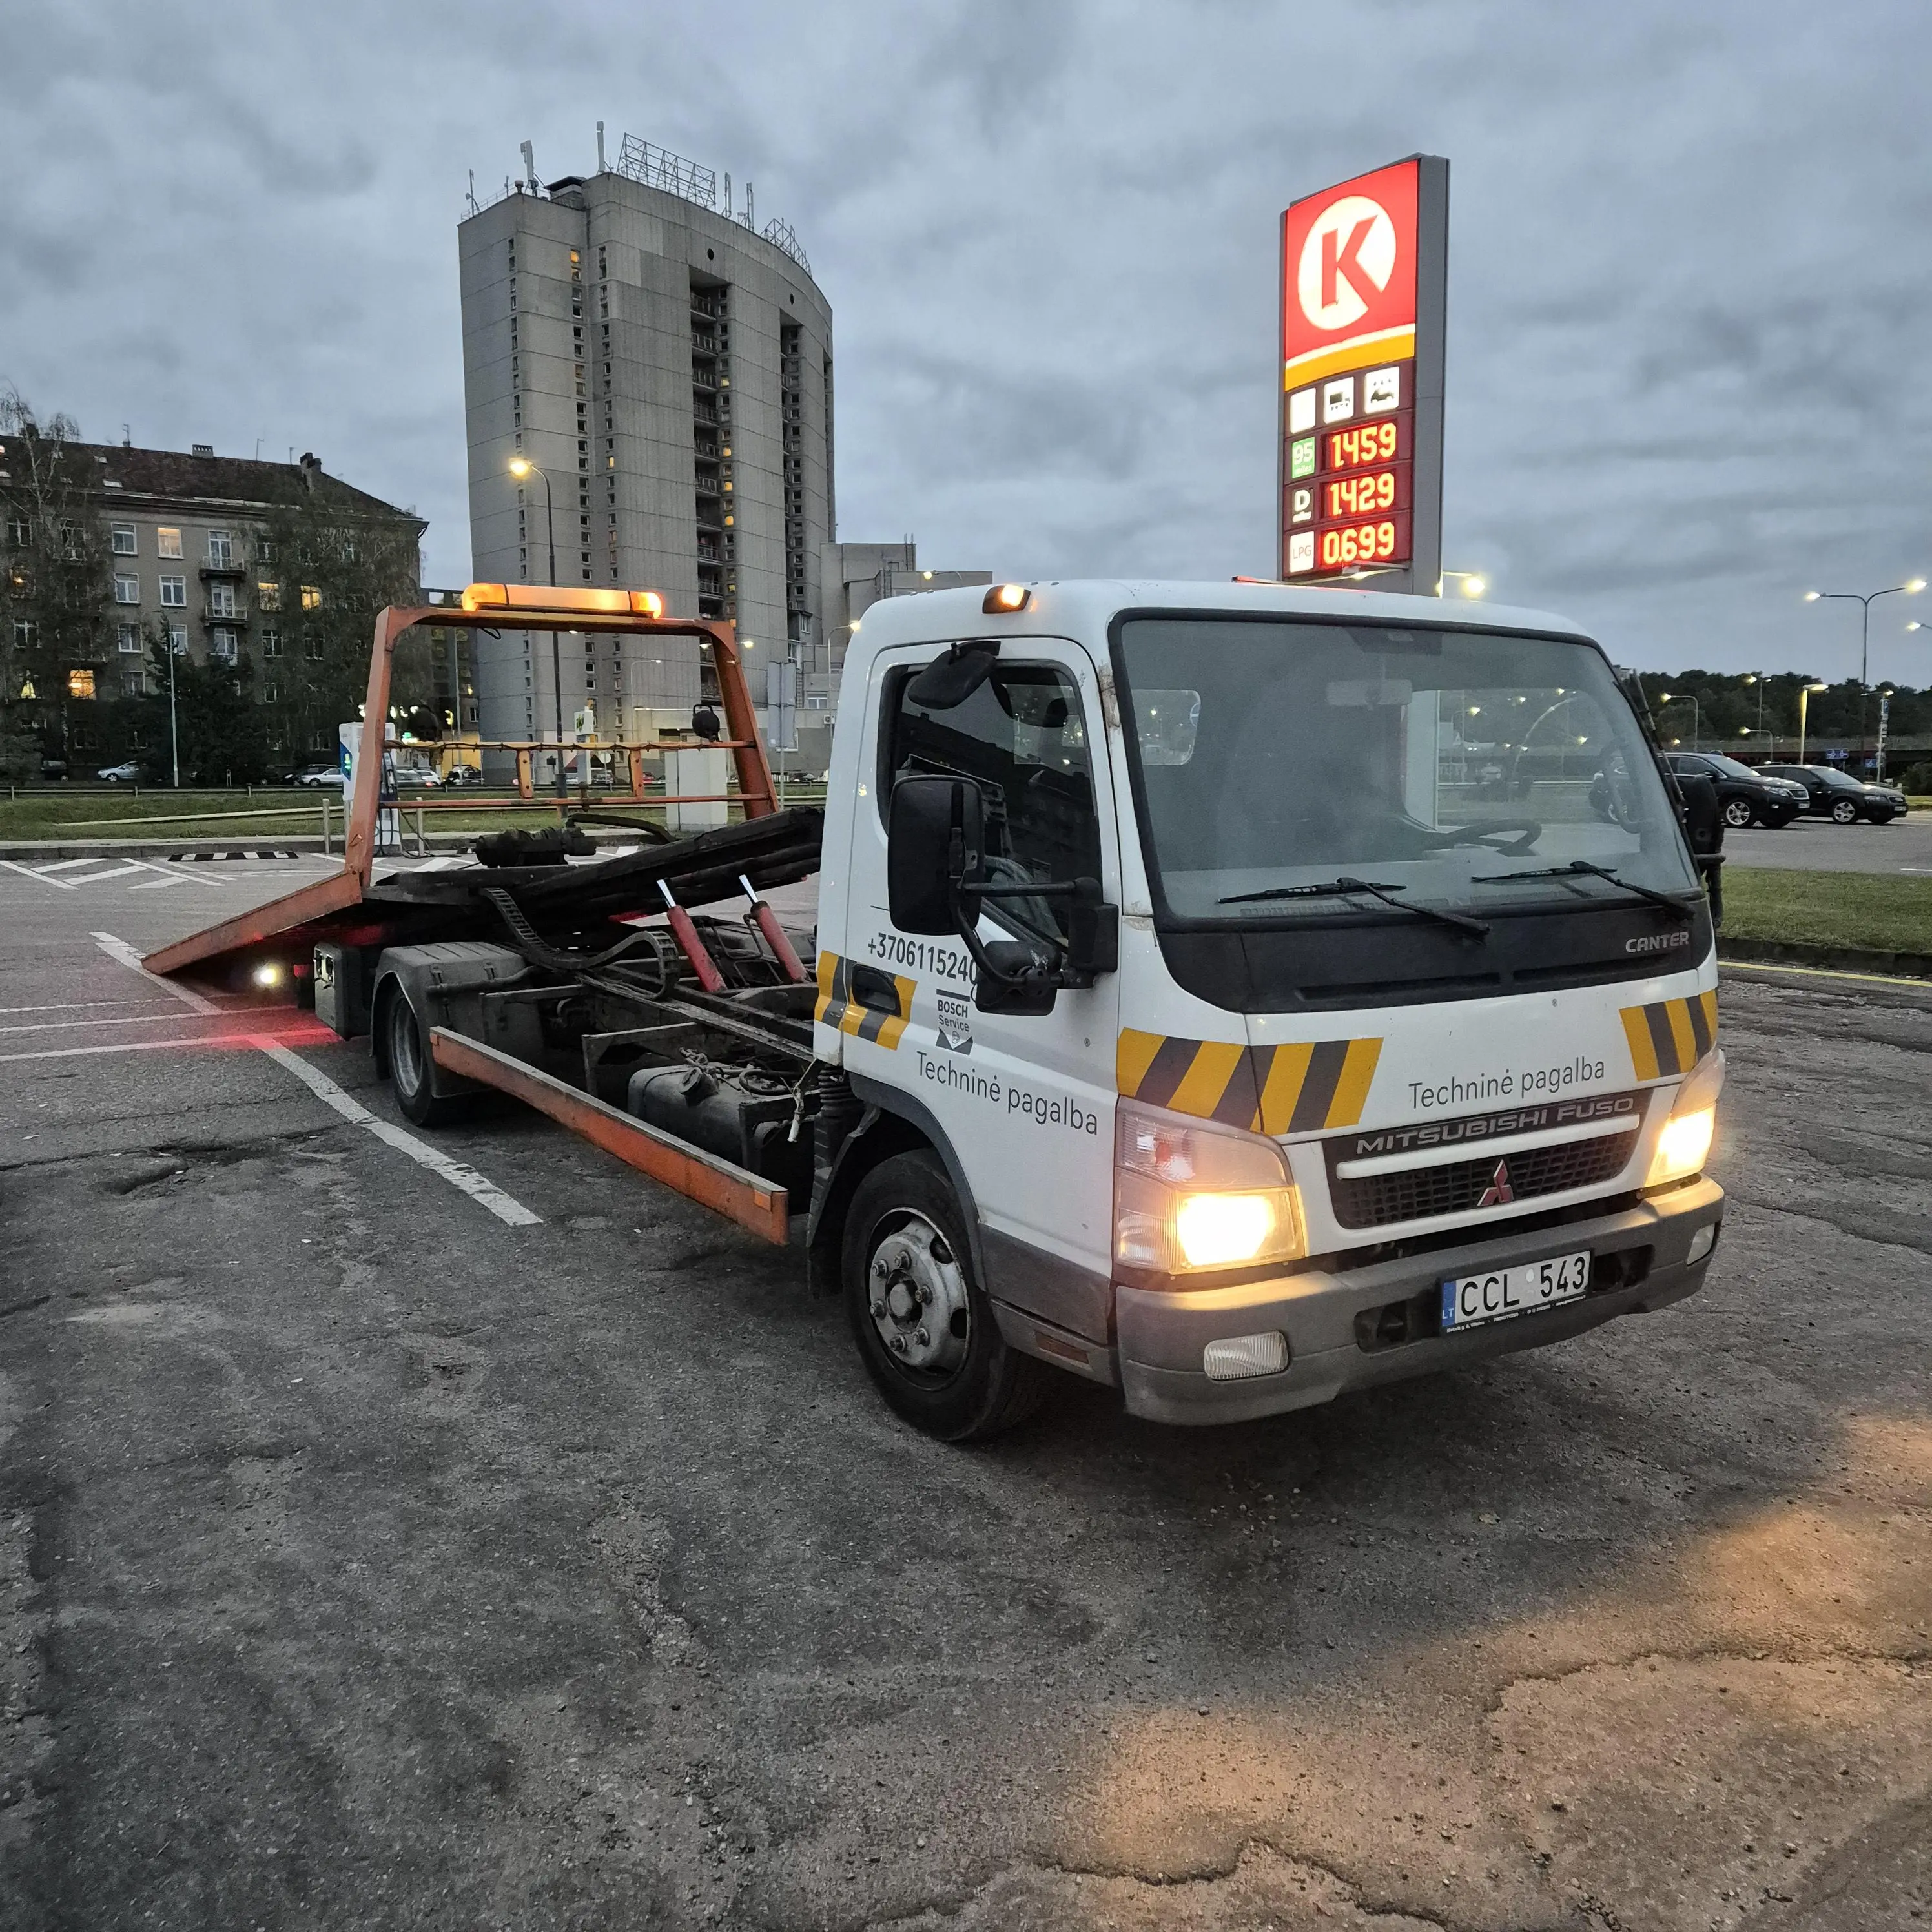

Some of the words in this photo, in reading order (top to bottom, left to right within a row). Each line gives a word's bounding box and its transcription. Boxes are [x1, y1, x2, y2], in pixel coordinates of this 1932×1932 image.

[1322, 214, 1382, 309] K
[1293, 442, 1313, 465] 95
[1295, 490, 1310, 512] D
[1293, 545, 1312, 559] LPG
[1625, 932, 1689, 952] CANTER
[938, 1000, 968, 1018] BOSCH
[938, 1014, 969, 1032] Service
[917, 1051, 1000, 1102] Techninė
[1007, 1087, 1098, 1135] pagalba
[1409, 1069, 1512, 1109] Techninė
[1521, 1056, 1605, 1098] pagalba
[1357, 1109, 1547, 1155] MITSUBISHI
[1557, 1098, 1633, 1121] FUSO
[1461, 1274, 1519, 1316] CCL
[1541, 1257, 1585, 1297] 543
[1443, 1308, 1454, 1319] LT
